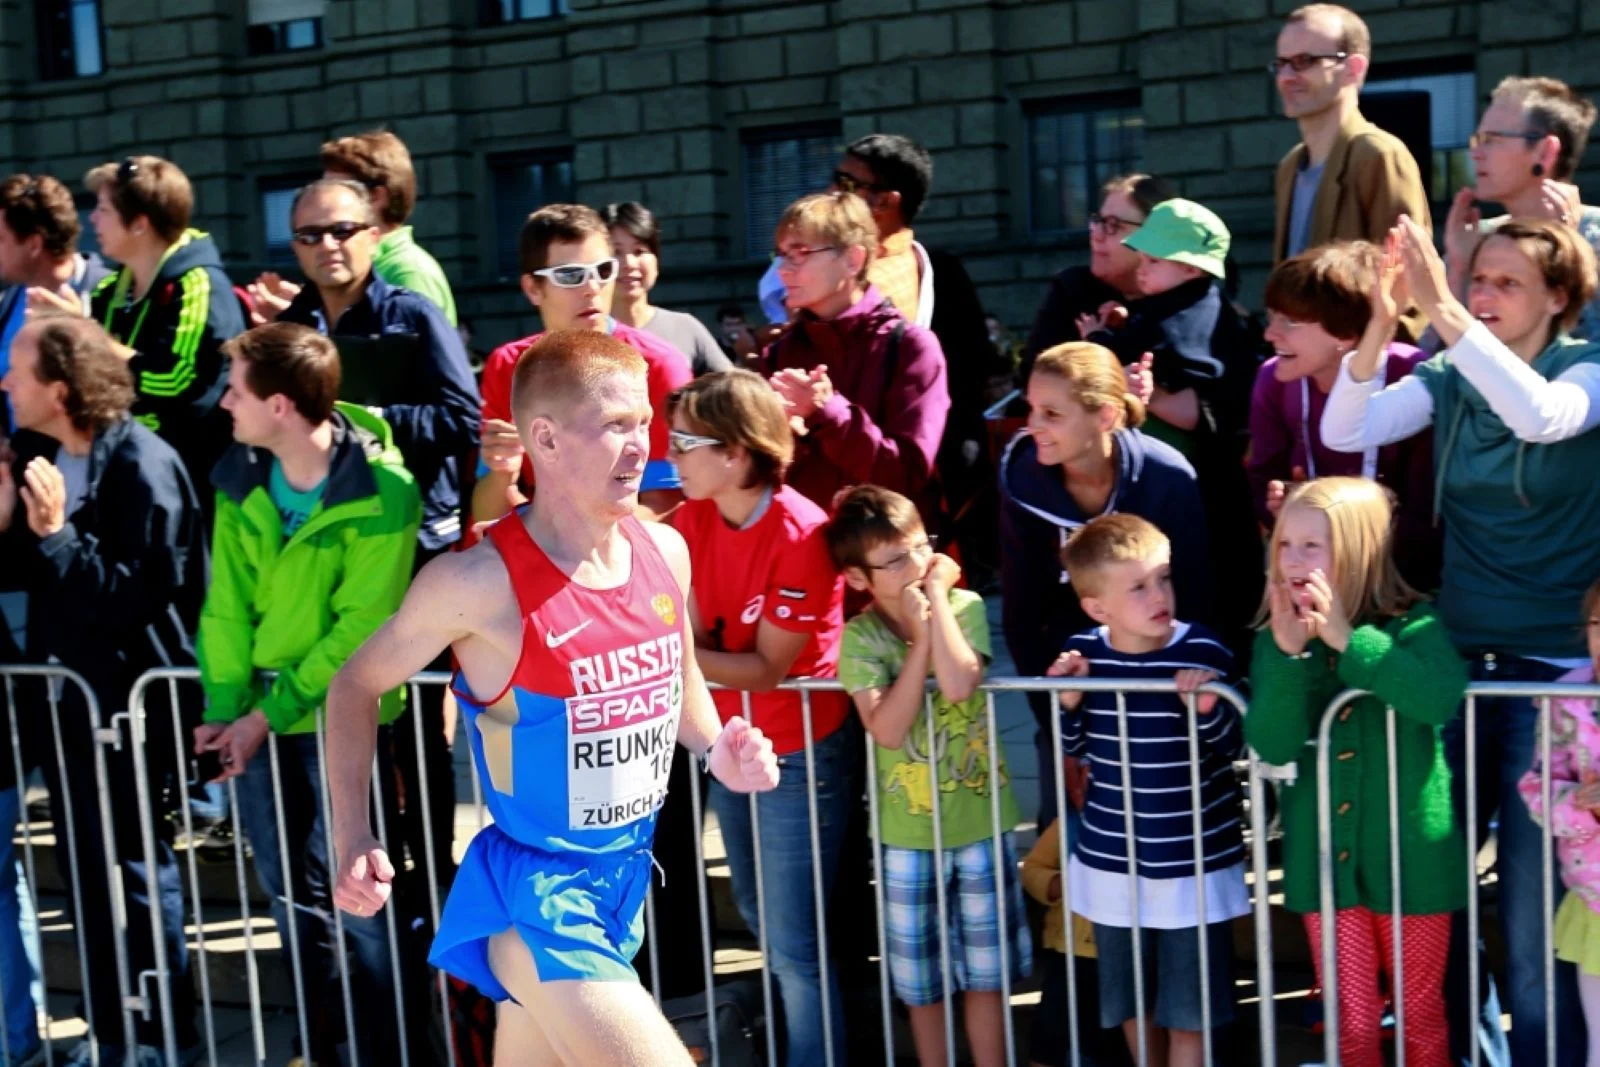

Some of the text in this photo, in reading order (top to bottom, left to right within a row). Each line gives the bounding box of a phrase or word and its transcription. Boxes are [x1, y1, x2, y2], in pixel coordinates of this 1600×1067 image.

[570, 632, 682, 697] RUSSIA
[575, 686, 669, 729] SPAR
[583, 793, 653, 826] ZÜRICH
